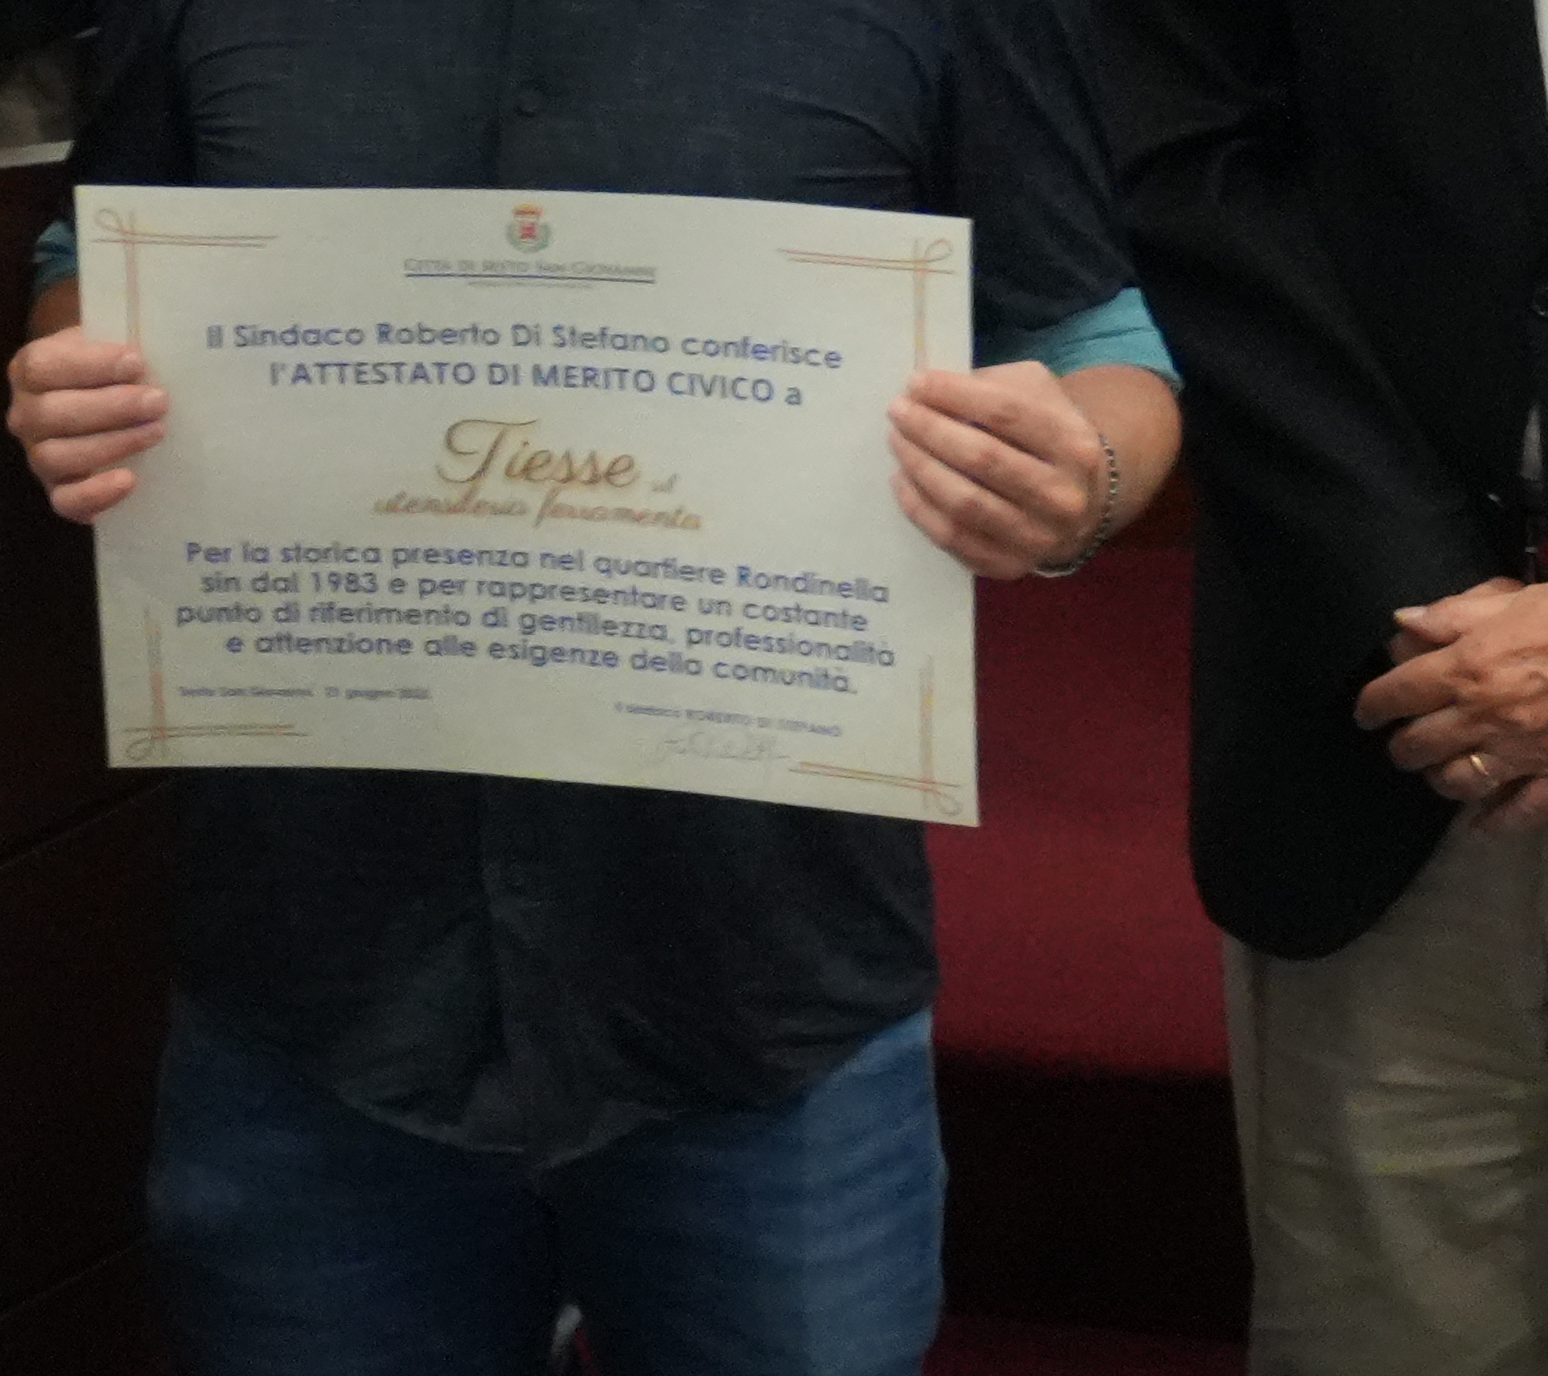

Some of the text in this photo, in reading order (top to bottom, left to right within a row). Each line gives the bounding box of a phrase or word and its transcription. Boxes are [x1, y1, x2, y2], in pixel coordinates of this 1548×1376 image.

[207, 322, 842, 369] Il Sindaco Roberto Di Stefano conferisce
[270, 361, 802, 406] l'ATTESTATO DI MERITO CIVICO a
[436, 419, 639, 488] Tiesse
[187, 541, 890, 604] Per la storica presenza nel quartiere Rondinella
[199, 571, 869, 630] sin dal 1983 e per rappresentare un costante
[176, 599, 895, 667] punto di riferimento di gentilezza, professionalità
[225, 631, 858, 695] e attenzione alle esigenze della comunità.
